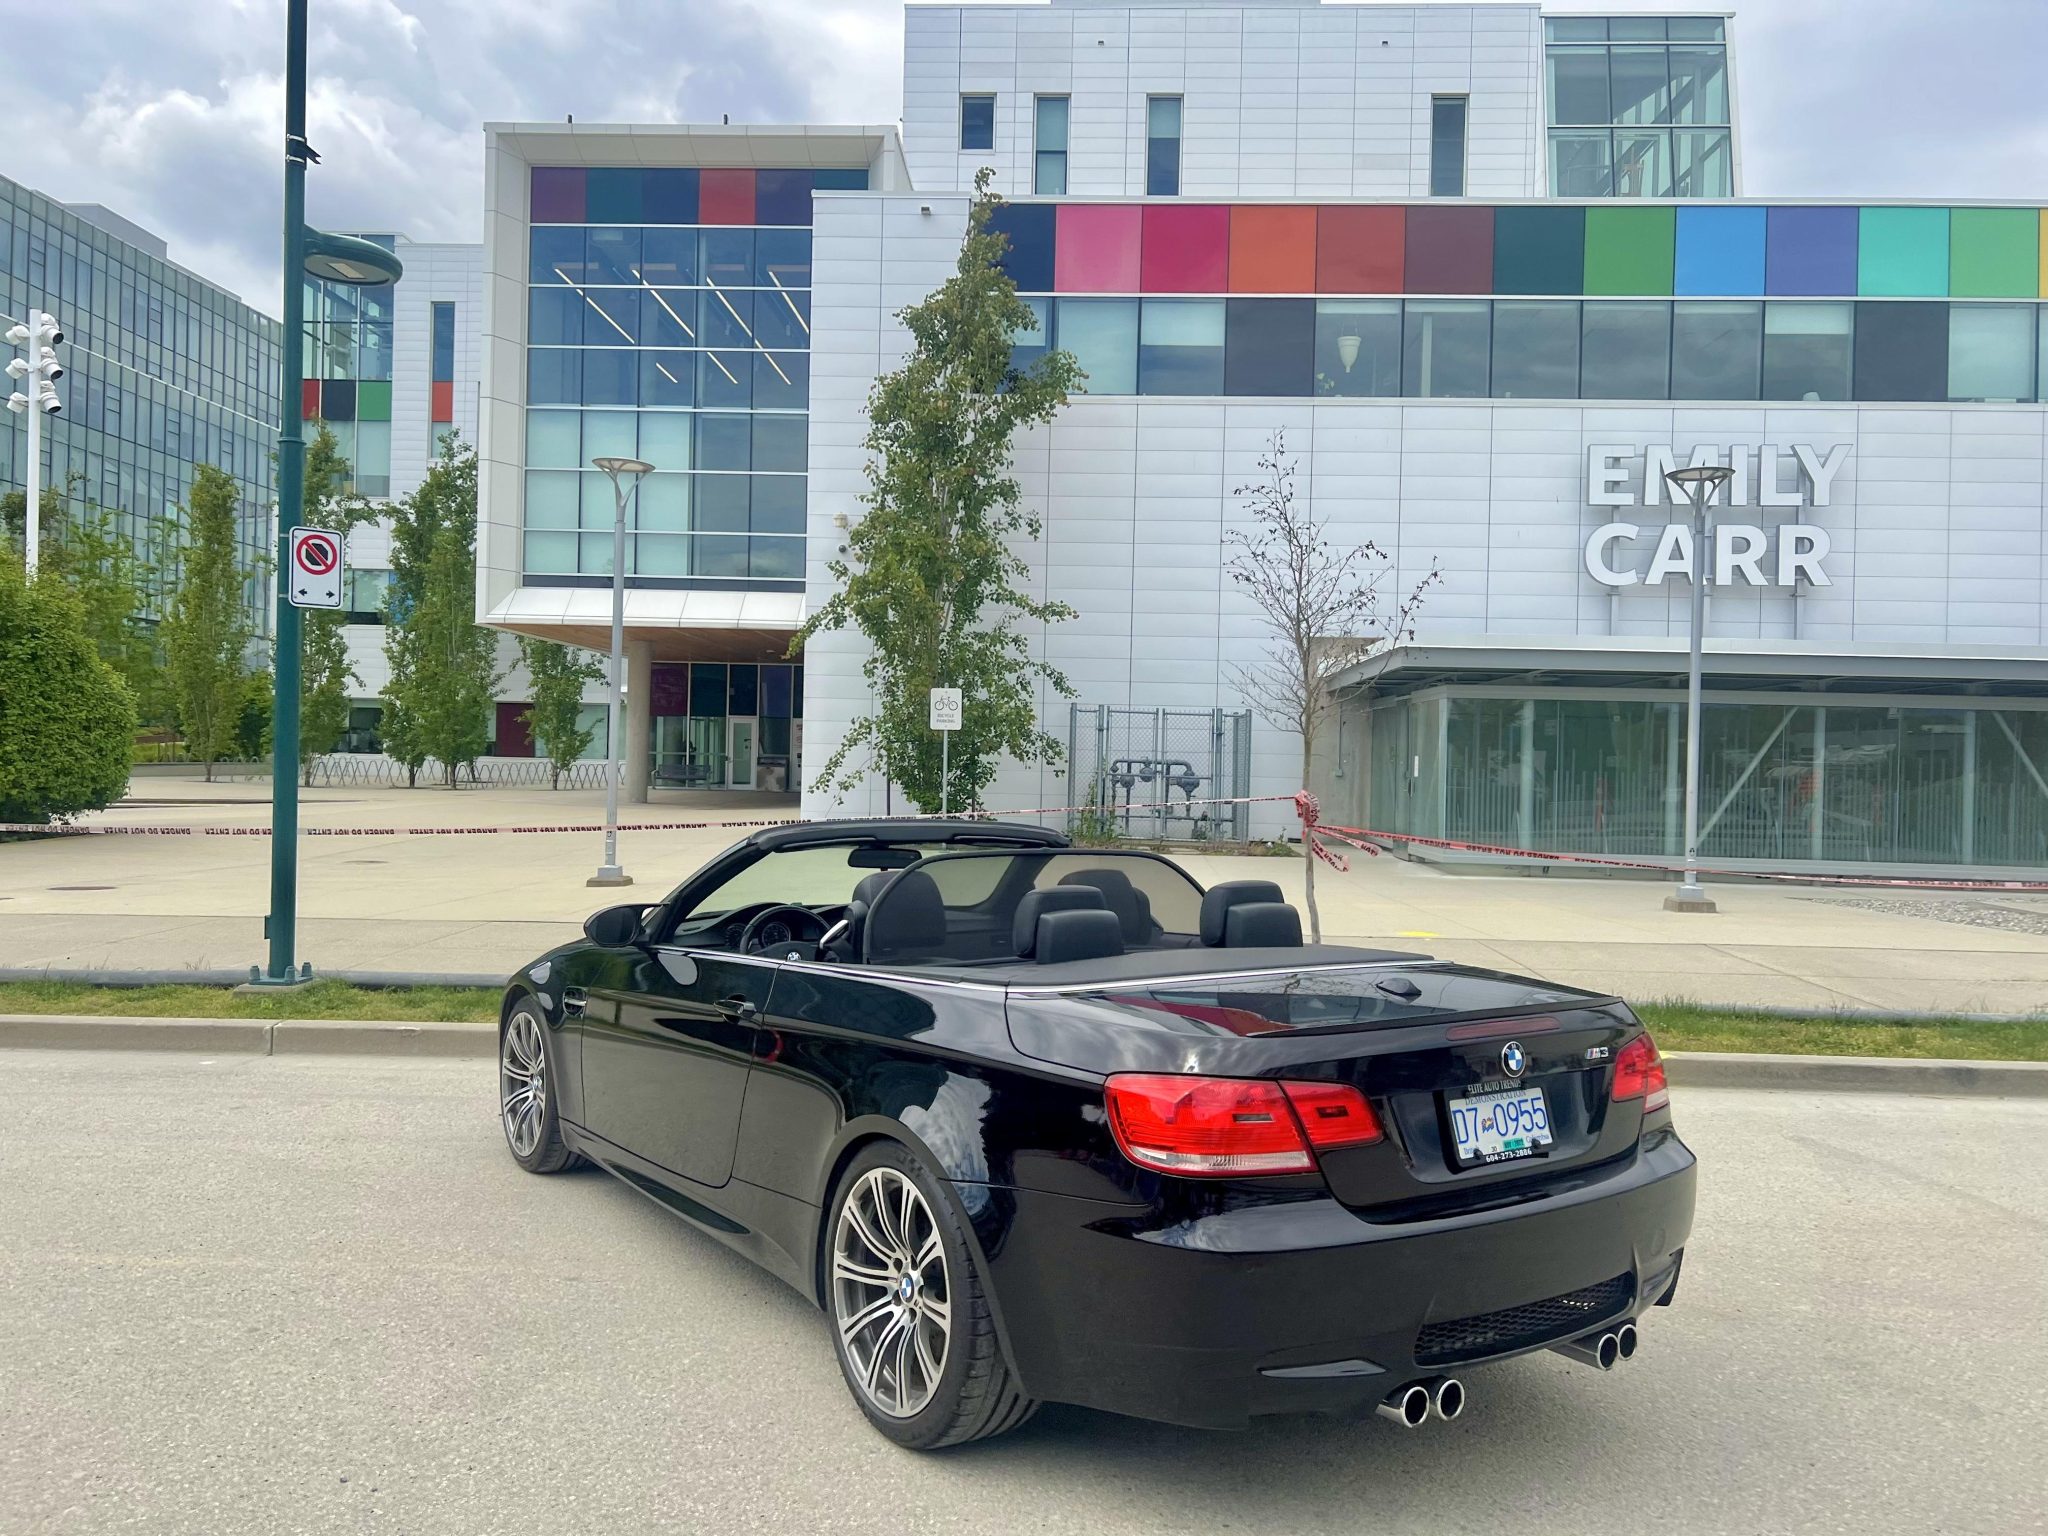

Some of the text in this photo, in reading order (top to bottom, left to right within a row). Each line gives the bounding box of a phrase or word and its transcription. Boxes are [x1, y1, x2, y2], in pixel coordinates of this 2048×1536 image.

[1588, 443, 1853, 507] EMILY
[1584, 522, 1833, 586] CARR
[104, 827, 128, 835] ENTER
[131, 827, 146, 835] NOT
[148, 827, 159, 835] DO
[1484, 1081, 1500, 1092] AUTO
[1500, 1079, 1521, 1090] TRENDS
[1493, 1097, 1547, 1137] 0955
